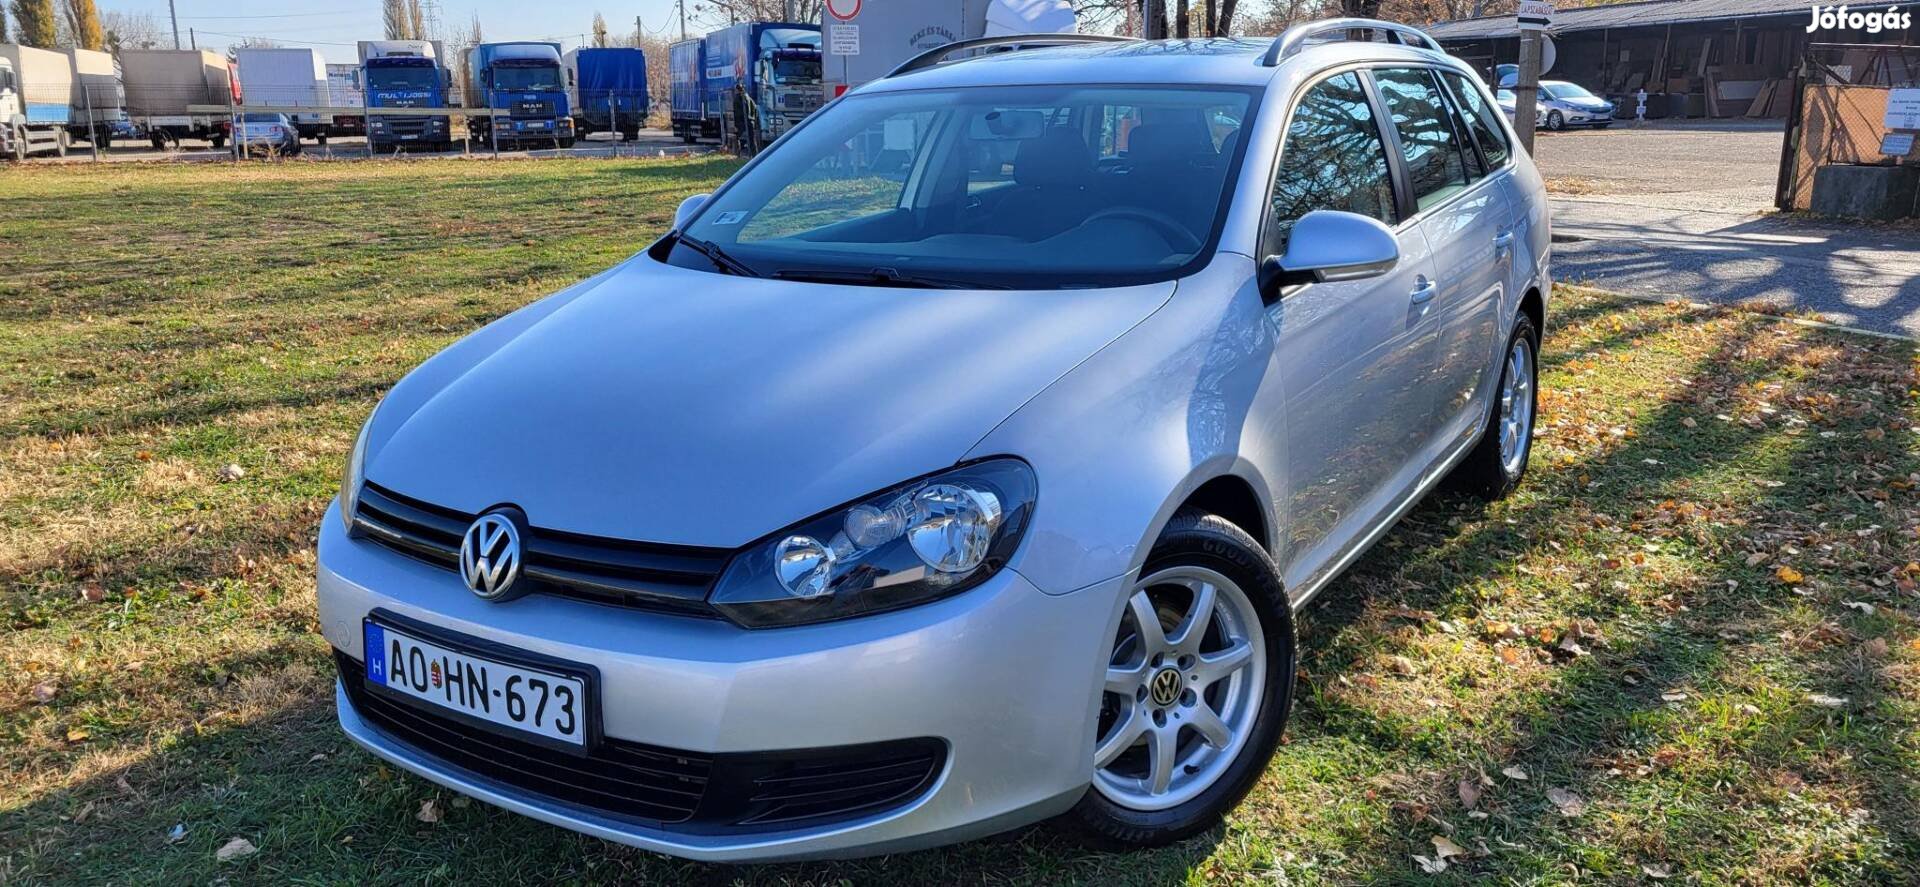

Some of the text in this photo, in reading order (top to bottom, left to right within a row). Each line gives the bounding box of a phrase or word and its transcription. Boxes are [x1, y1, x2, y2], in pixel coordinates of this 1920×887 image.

[372, 658, 382, 677] H
[390, 639, 577, 736] AO HN-673
